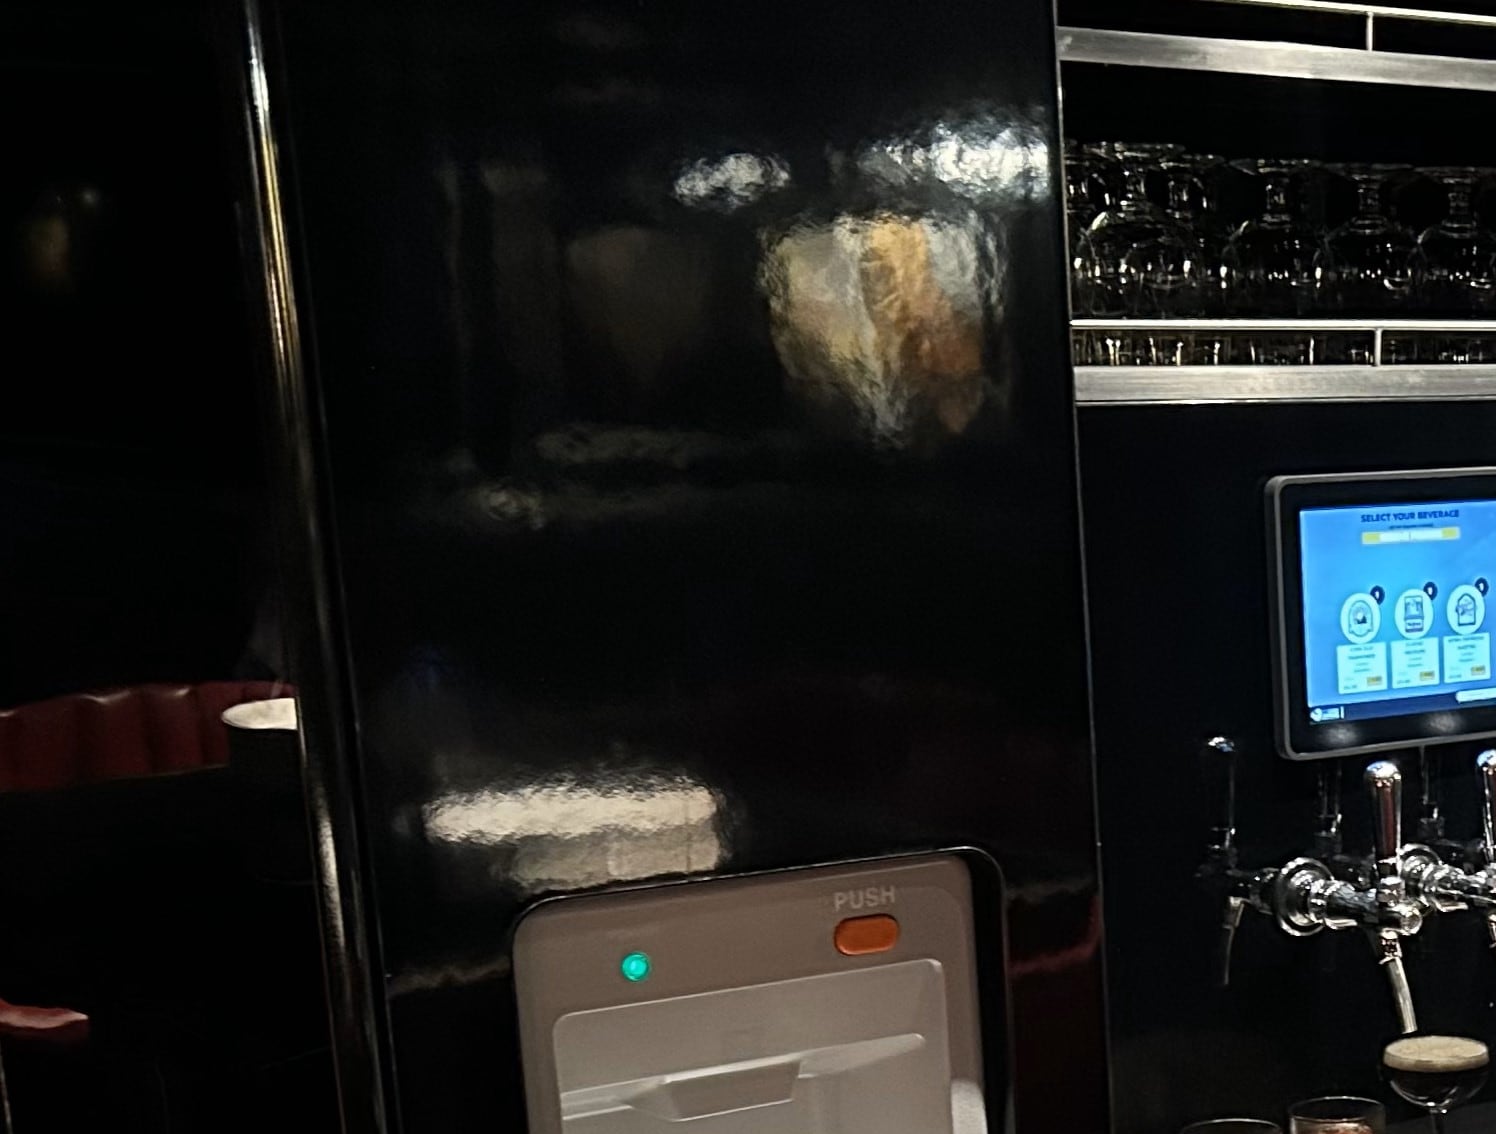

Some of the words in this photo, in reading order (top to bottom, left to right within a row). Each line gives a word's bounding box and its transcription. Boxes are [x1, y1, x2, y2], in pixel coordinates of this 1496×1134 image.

[1361, 513, 1390, 523] SELECT
[1393, 511, 1415, 521] YOUR
[1418, 509, 1459, 520] BEVERAGE
[834, 885, 896, 911] PUSH
